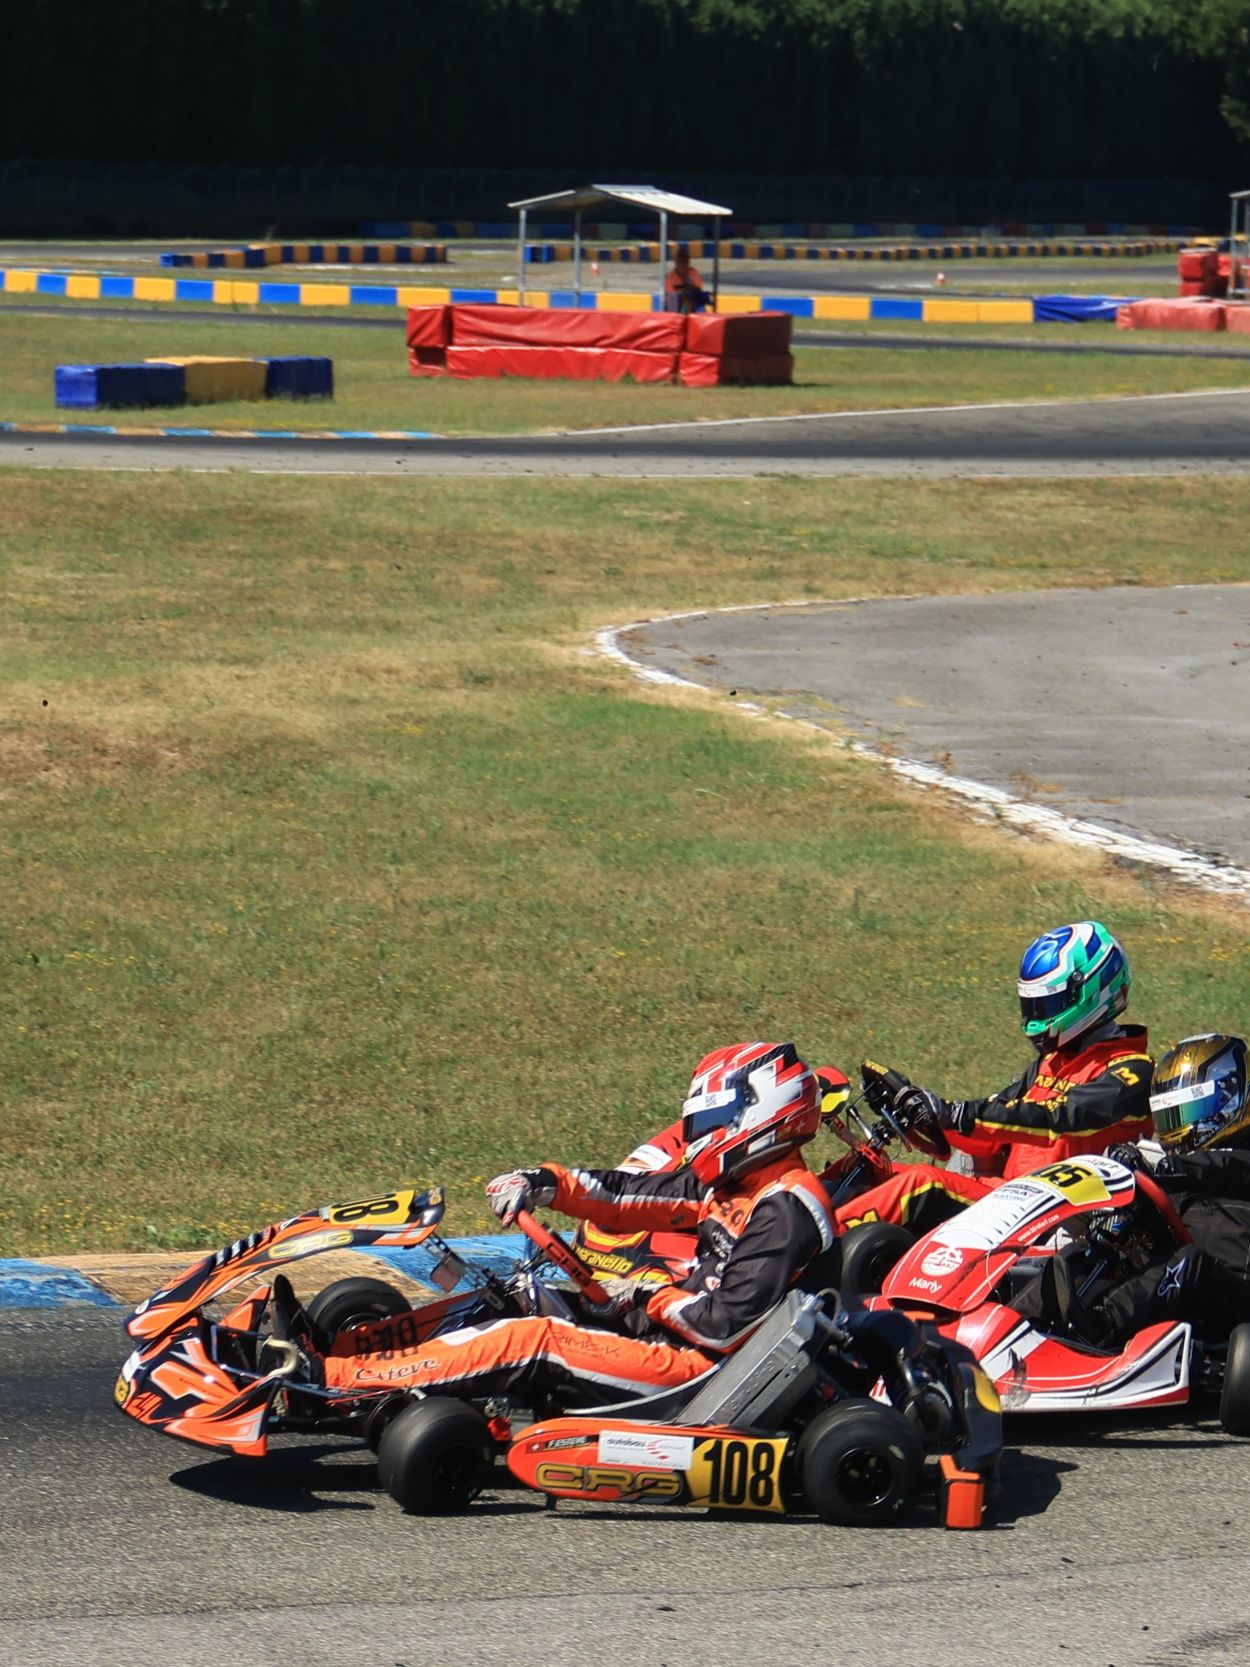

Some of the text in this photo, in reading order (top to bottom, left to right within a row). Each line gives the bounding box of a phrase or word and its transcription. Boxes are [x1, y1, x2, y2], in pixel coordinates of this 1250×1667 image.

[908, 1276, 943, 1294] Marly
[536, 1462, 683, 1496] CRG
[703, 1439, 775, 1506] 108
